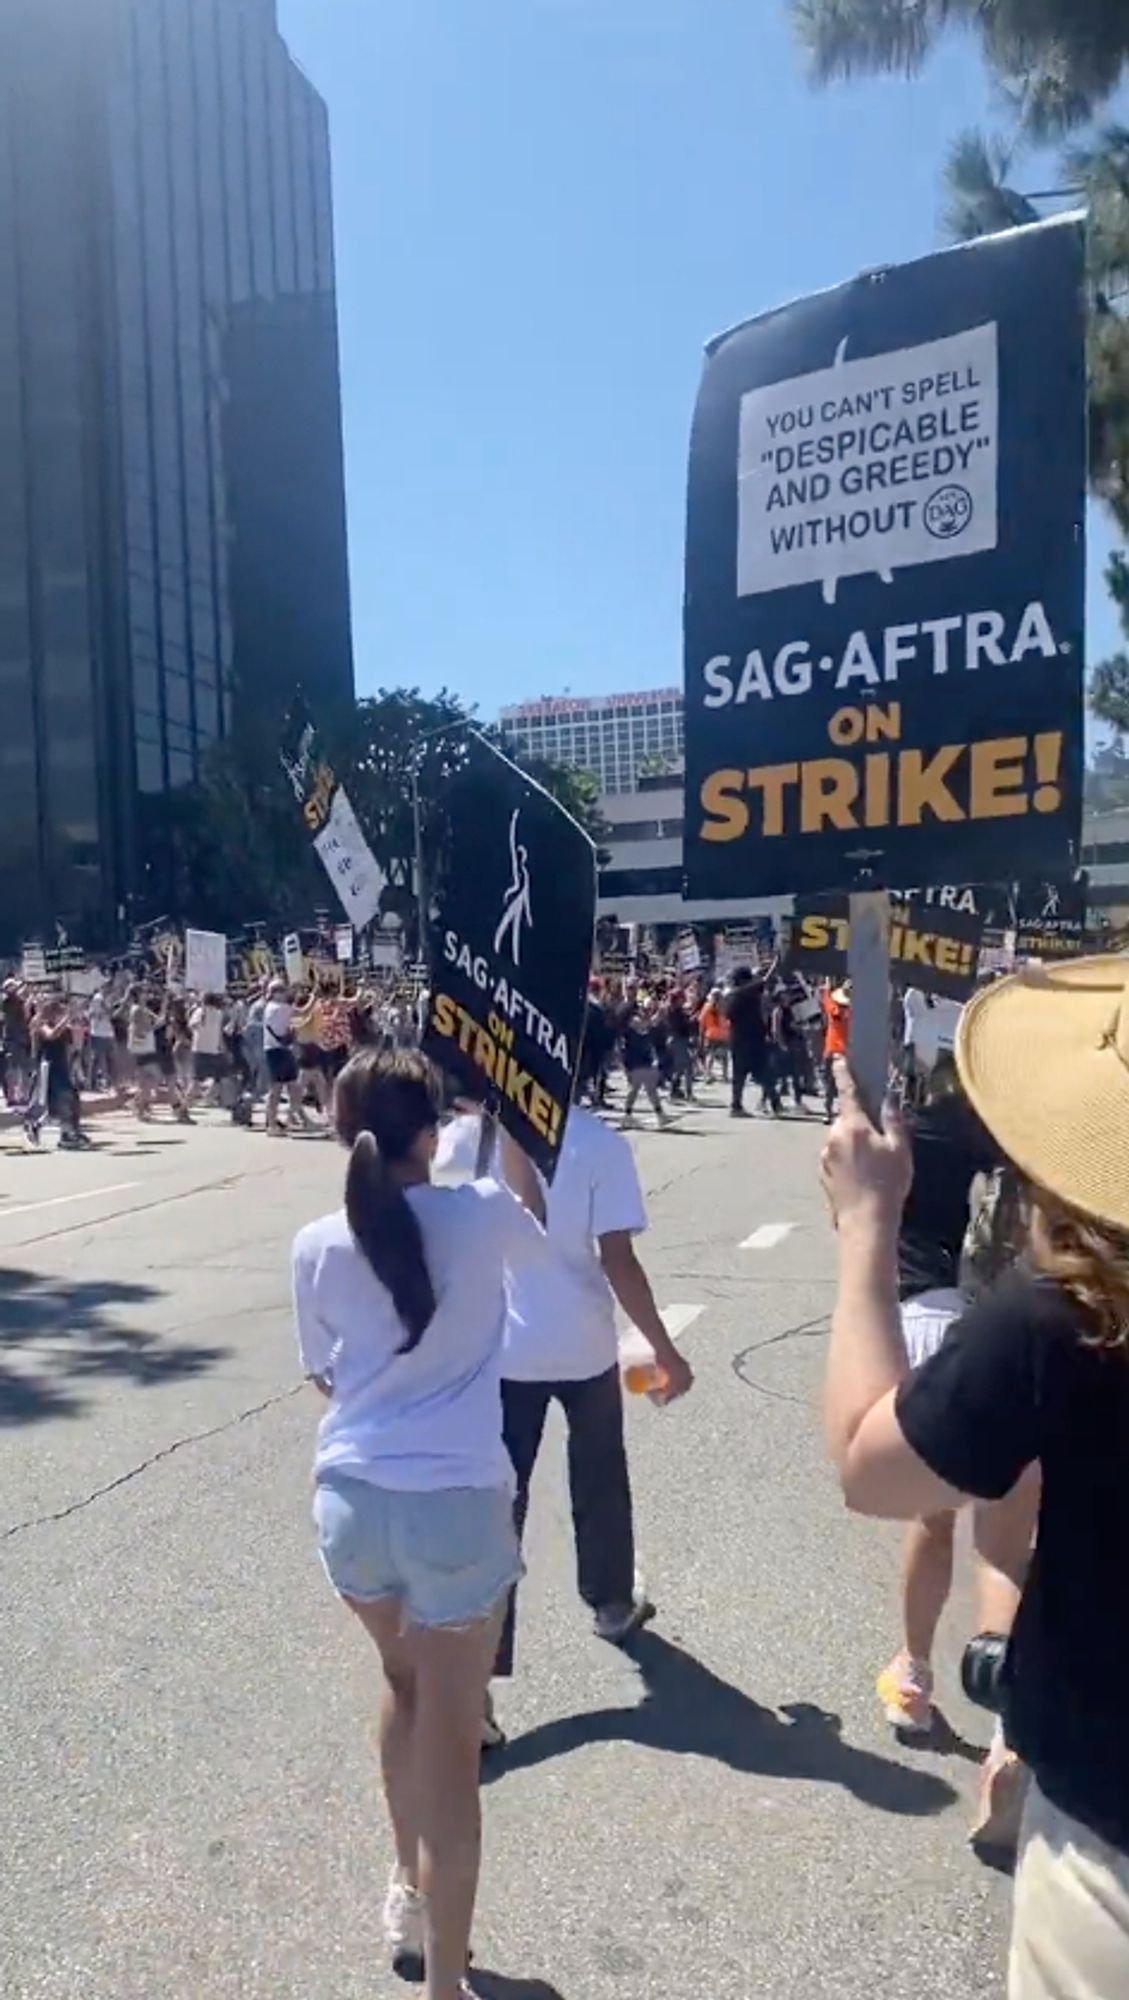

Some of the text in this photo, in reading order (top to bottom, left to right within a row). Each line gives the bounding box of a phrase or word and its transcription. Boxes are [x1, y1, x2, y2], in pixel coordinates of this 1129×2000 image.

[760, 400, 980, 475] "DESPICABLE
[766, 366, 981, 438] YOU CAN'T SPELL
[766, 436, 990, 513] AND GREEDY"
[770, 500, 917, 555] WITHOUT
[827, 701, 900, 746] ON
[699, 731, 1063, 843] STRIKE!
[486, 1010, 514, 1048] ON
[432, 993, 562, 1147] STRIKE!
